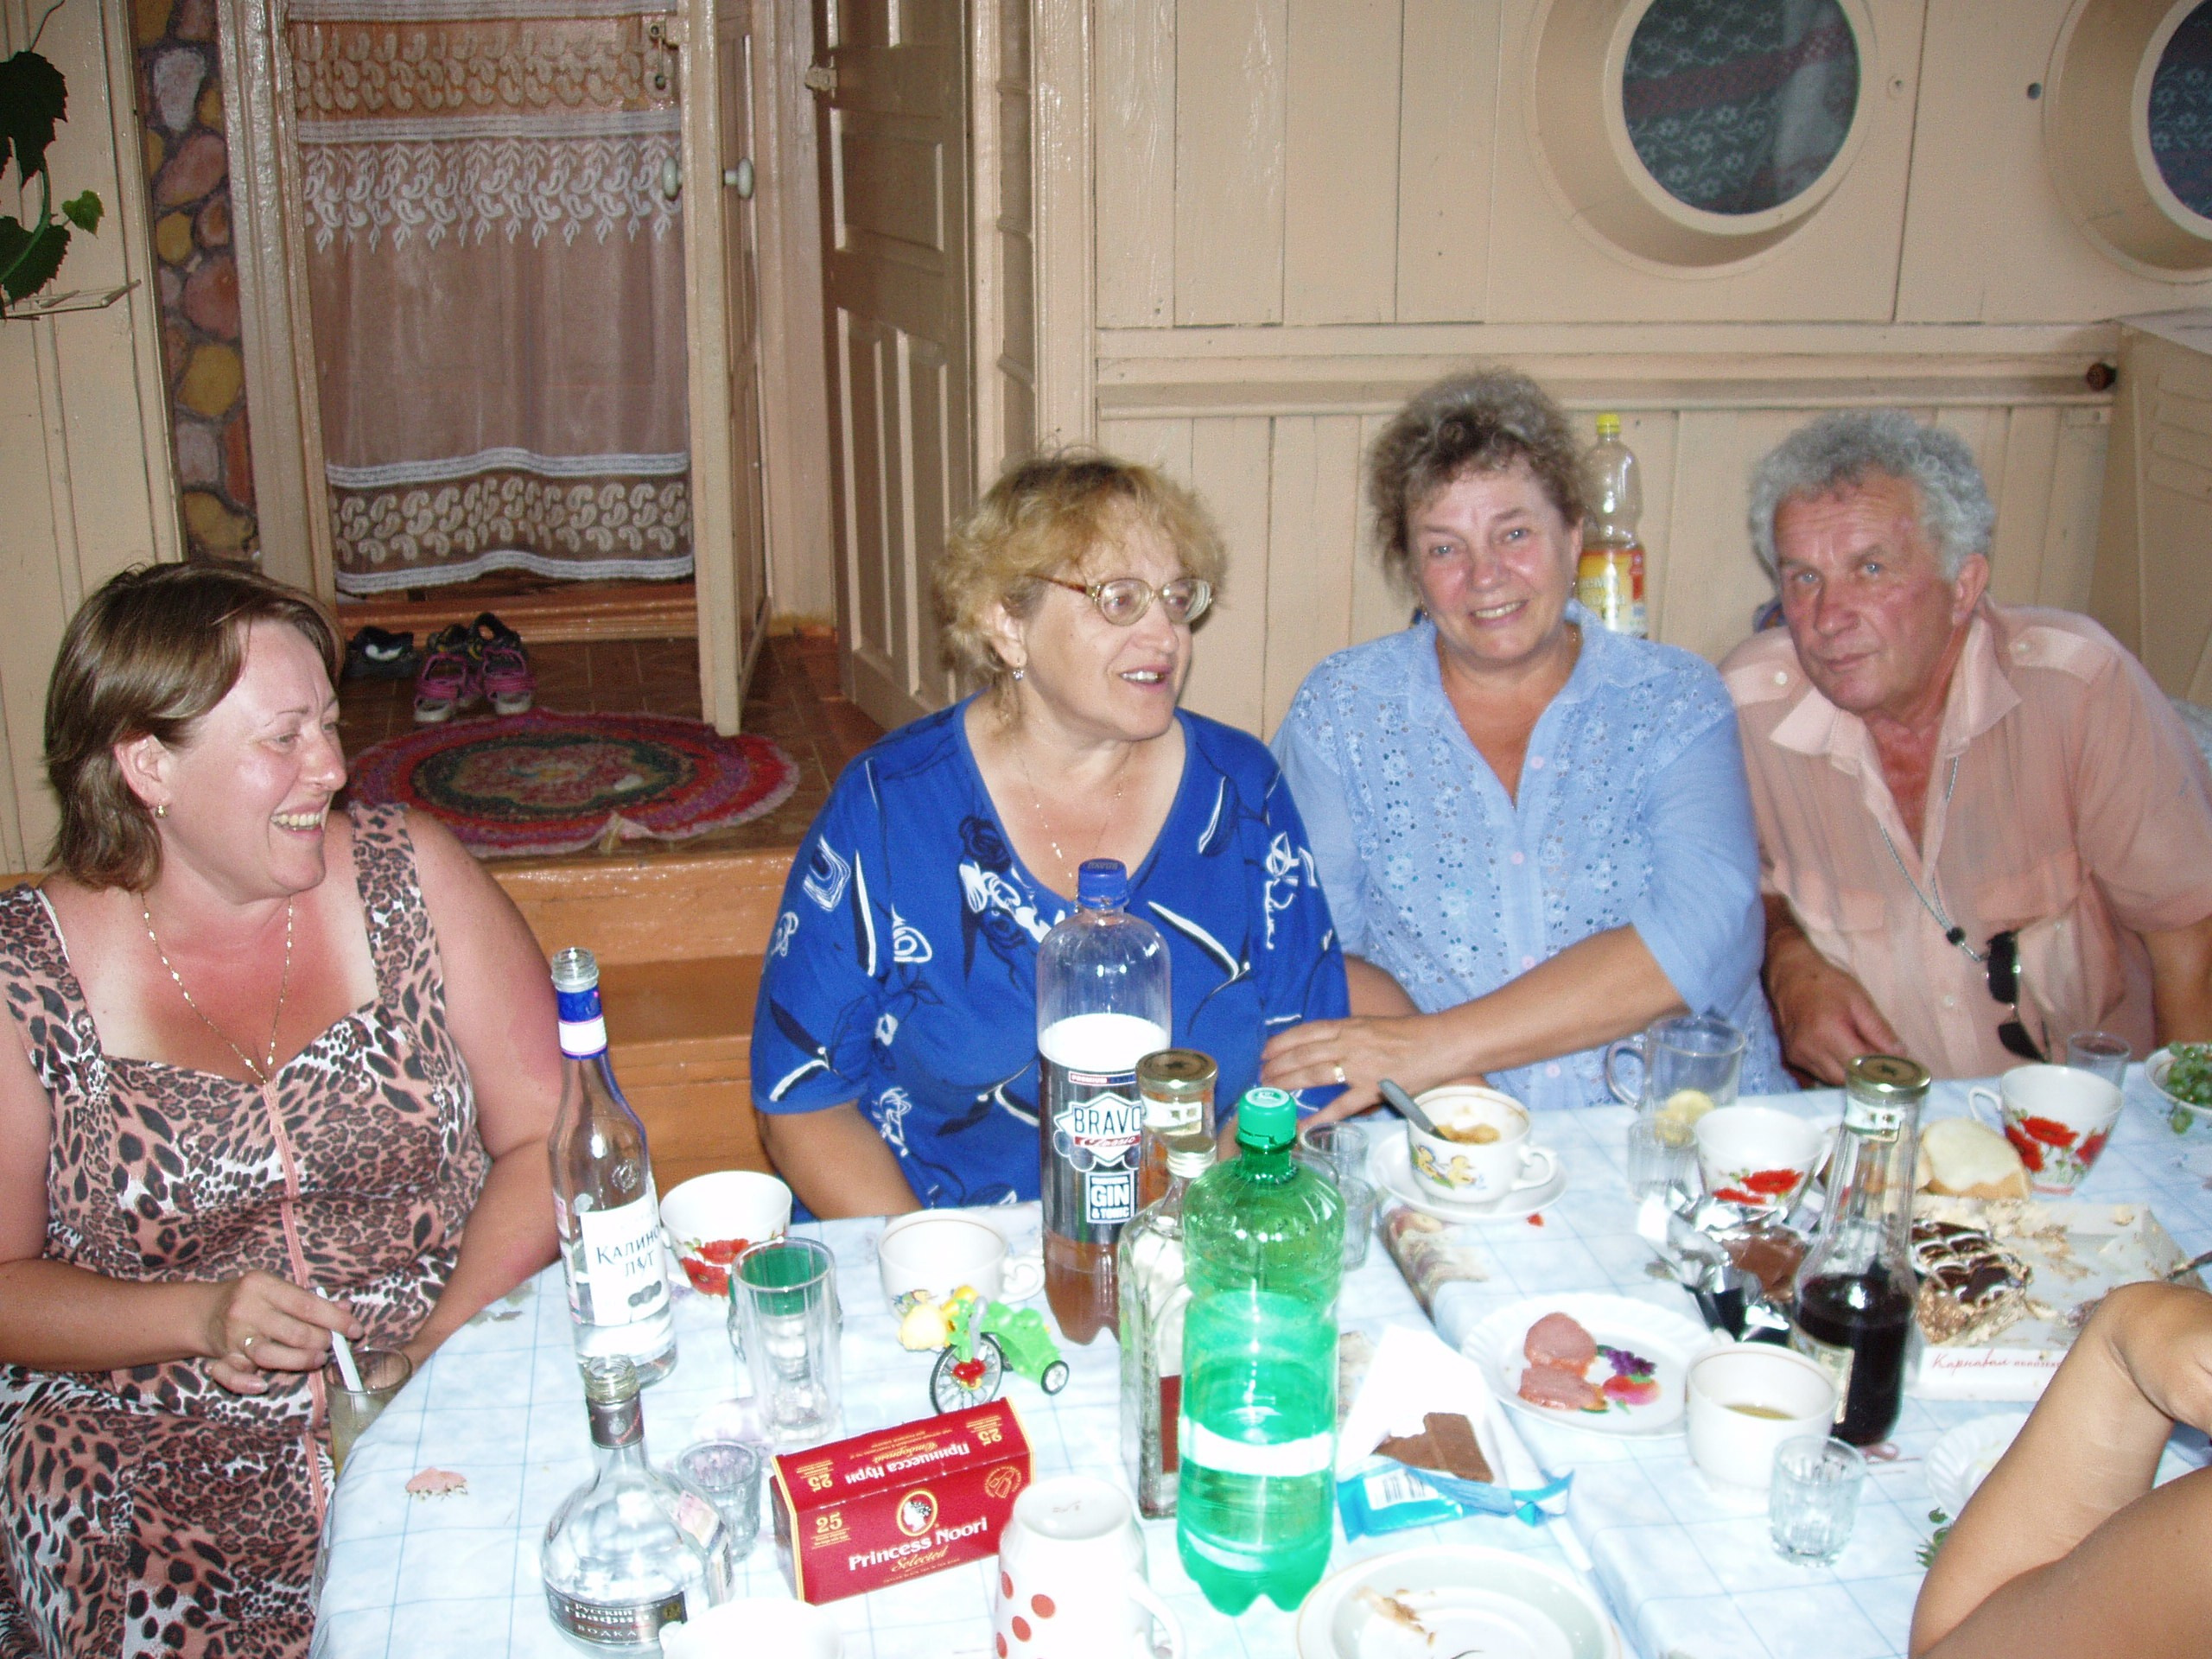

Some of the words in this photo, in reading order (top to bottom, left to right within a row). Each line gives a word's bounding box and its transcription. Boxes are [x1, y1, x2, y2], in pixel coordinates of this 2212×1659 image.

[1074, 1105, 1141, 1135] BRAVO
[1090, 1184, 1129, 1207] GIN
[1100, 1206, 1129, 1219] TONIC
[596, 1224, 661, 1264] КАЛИНО
[977, 1427, 1002, 1446] 25
[887, 1442, 970, 1472] Принцесса
[808, 1473, 833, 1492] 25
[845, 1465, 885, 1484] Нури
[816, 1512, 842, 1534] 25
[849, 1536, 932, 1571] Princess
[935, 1516, 988, 1546] Noori
[891, 1545, 949, 1572] Selected
[577, 1624, 637, 1637] ВОДКА
